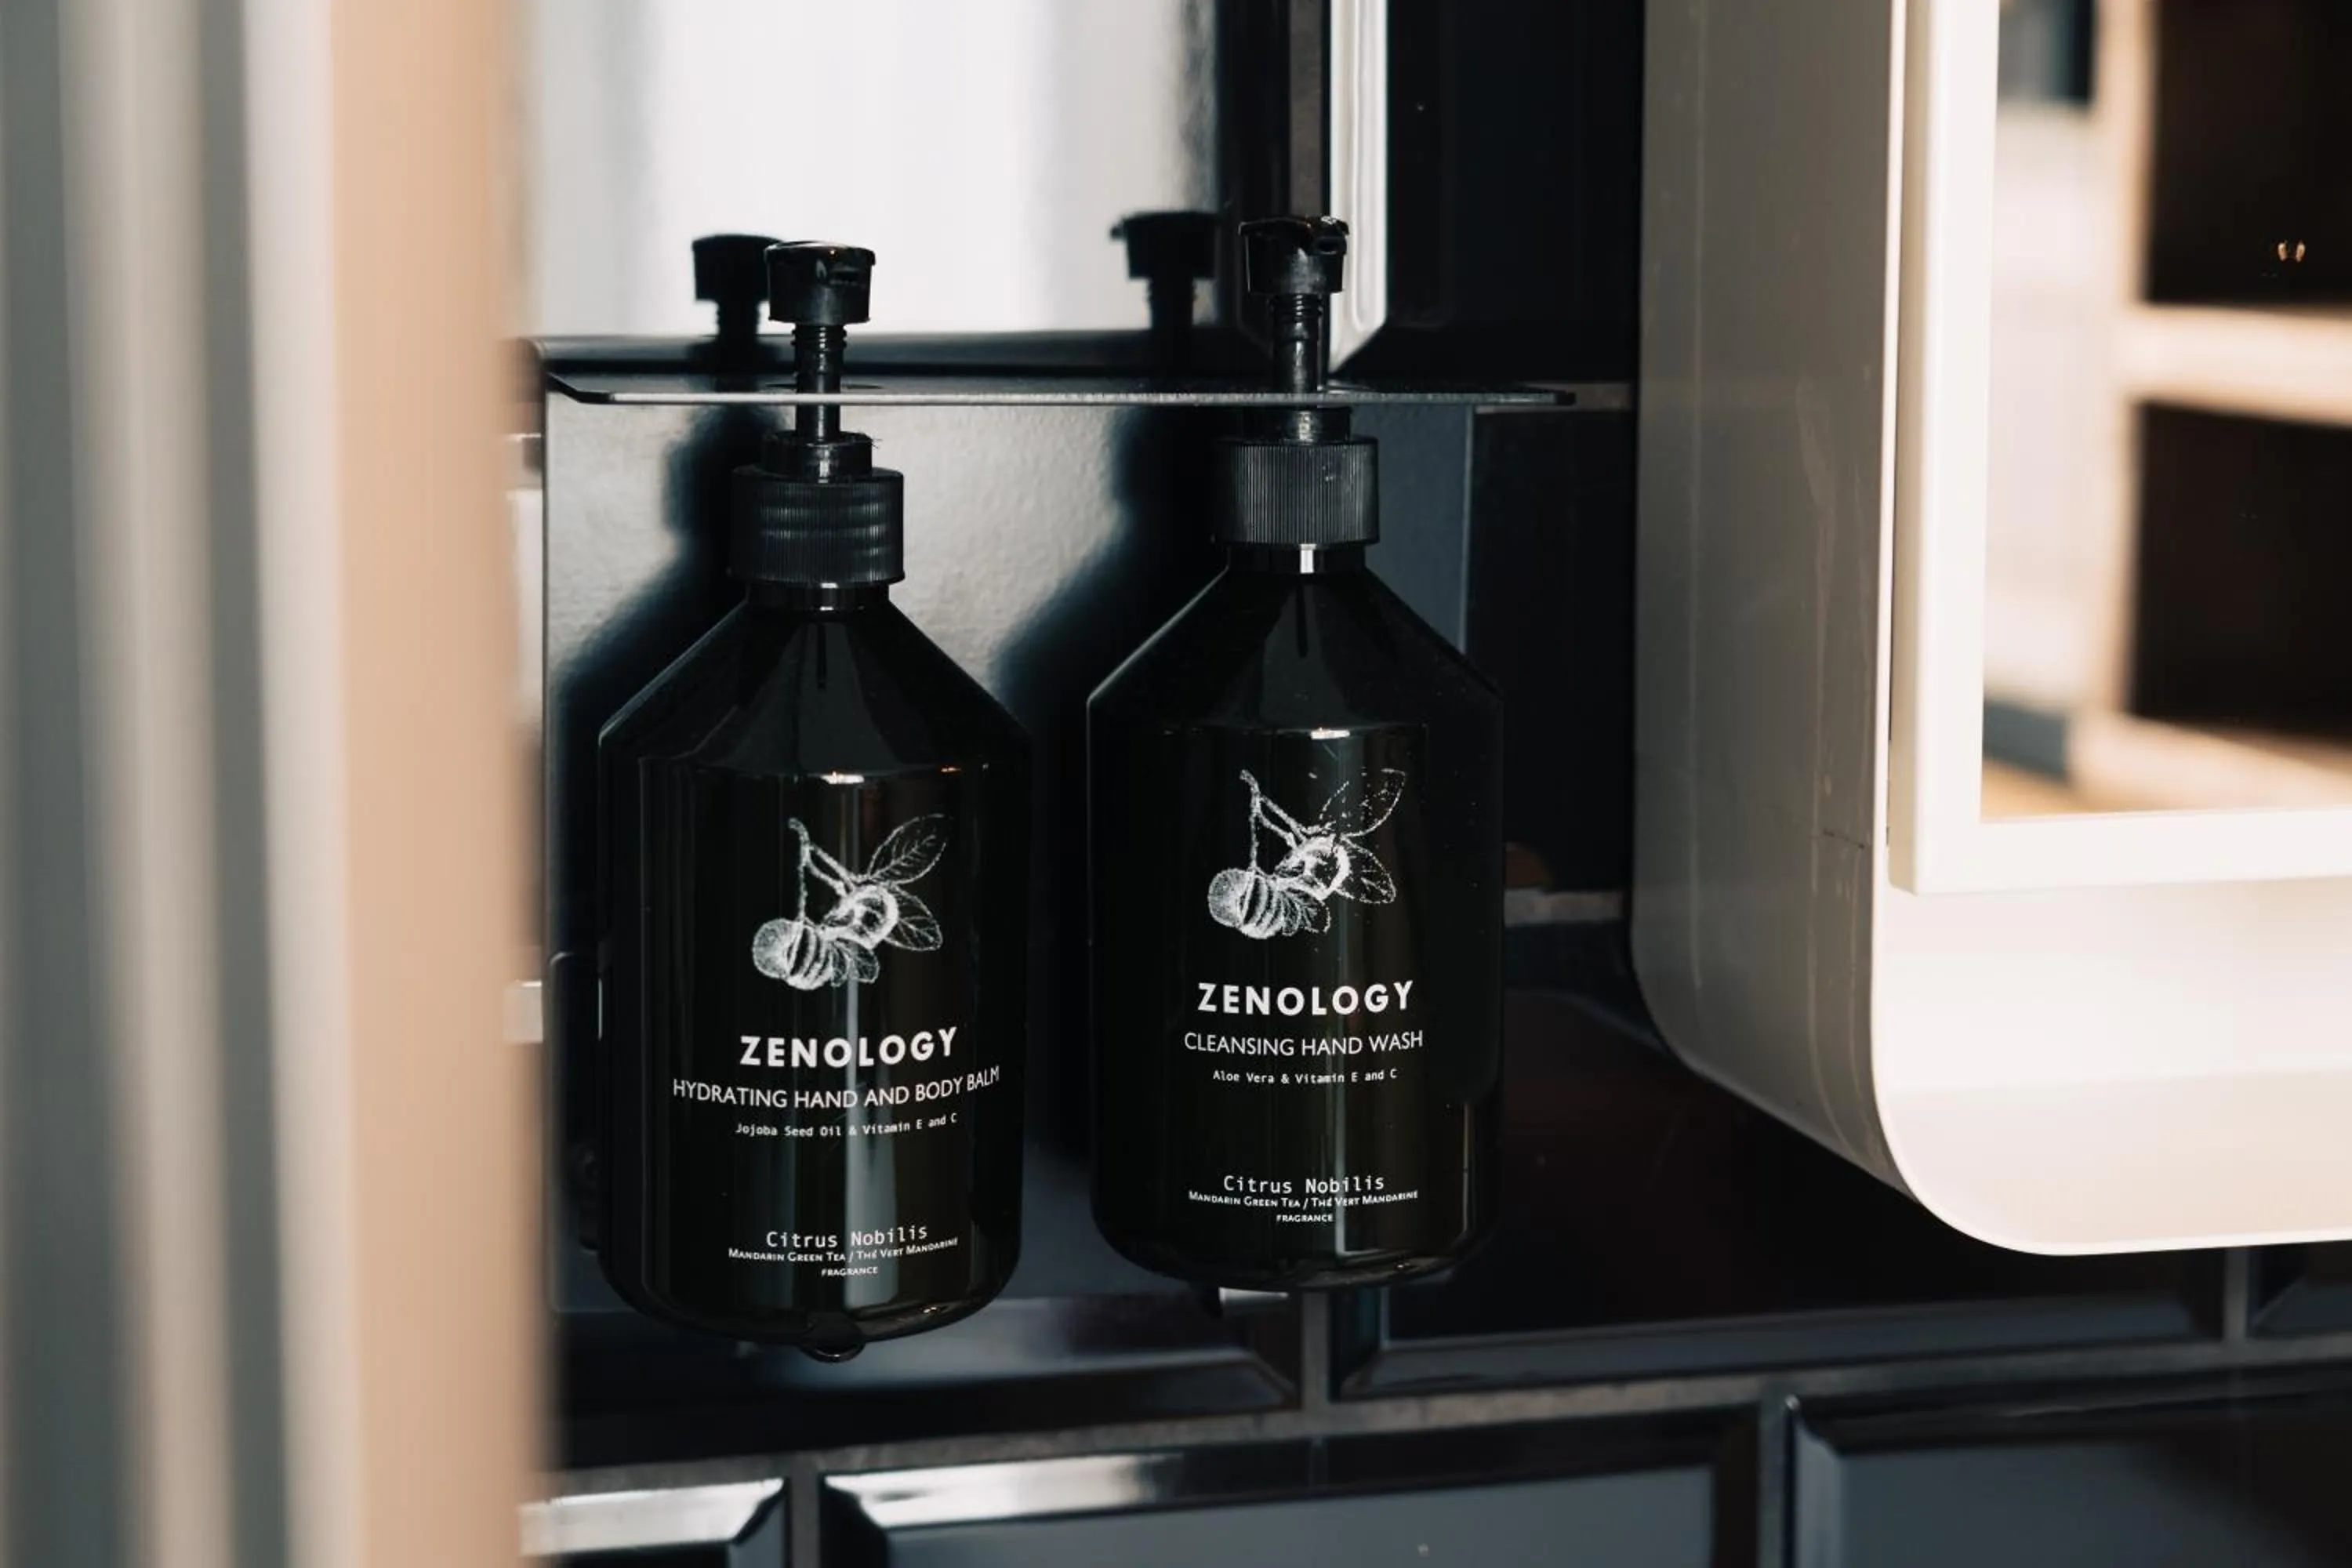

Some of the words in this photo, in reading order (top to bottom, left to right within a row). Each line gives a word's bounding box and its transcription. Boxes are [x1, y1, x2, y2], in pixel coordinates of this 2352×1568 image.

[1196, 980, 1414, 1016] ZENOLOGY
[739, 1026, 957, 1068] ZENOLOGY
[1184, 1032, 1295, 1056] CLEANSING
[1301, 1037, 1363, 1057] HAND
[1368, 1029, 1424, 1053] WASH
[673, 1078, 788, 1108] HYDRATING
[793, 1091, 858, 1109] HAND
[863, 1086, 910, 1107] AND
[915, 1076, 964, 1102] BODY
[967, 1065, 1000, 1091] BALM
[1213, 1069, 1240, 1082] Aloe
[1246, 1072, 1275, 1084] Vera
[1280, 1073, 1290, 1084] &
[1295, 1073, 1345, 1084] Vitamin
[1351, 1072, 1358, 1083] E
[1365, 1069, 1385, 1081] and
[1390, 1068, 1397, 1079] C
[735, 1123, 779, 1137] Jojoba
[784, 1125, 814, 1136] Seed
[819, 1125, 841, 1136] Oil
[848, 1125, 857, 1136] &
[862, 1121, 910, 1135] Vitamin
[916, 1118, 924, 1130] E
[928, 1115, 947, 1127] and
[951, 1112, 958, 1123] C
[1223, 1175, 1293, 1194] Citrus
[1305, 1174, 1385, 1194] Nobilis
[1276, 1214, 1334, 1223] FRAGRANCE
[766, 1231, 838, 1248] Citrus
[851, 1225, 927, 1247] Nobilis
[821, 1266, 878, 1277] FRAGRANCE
